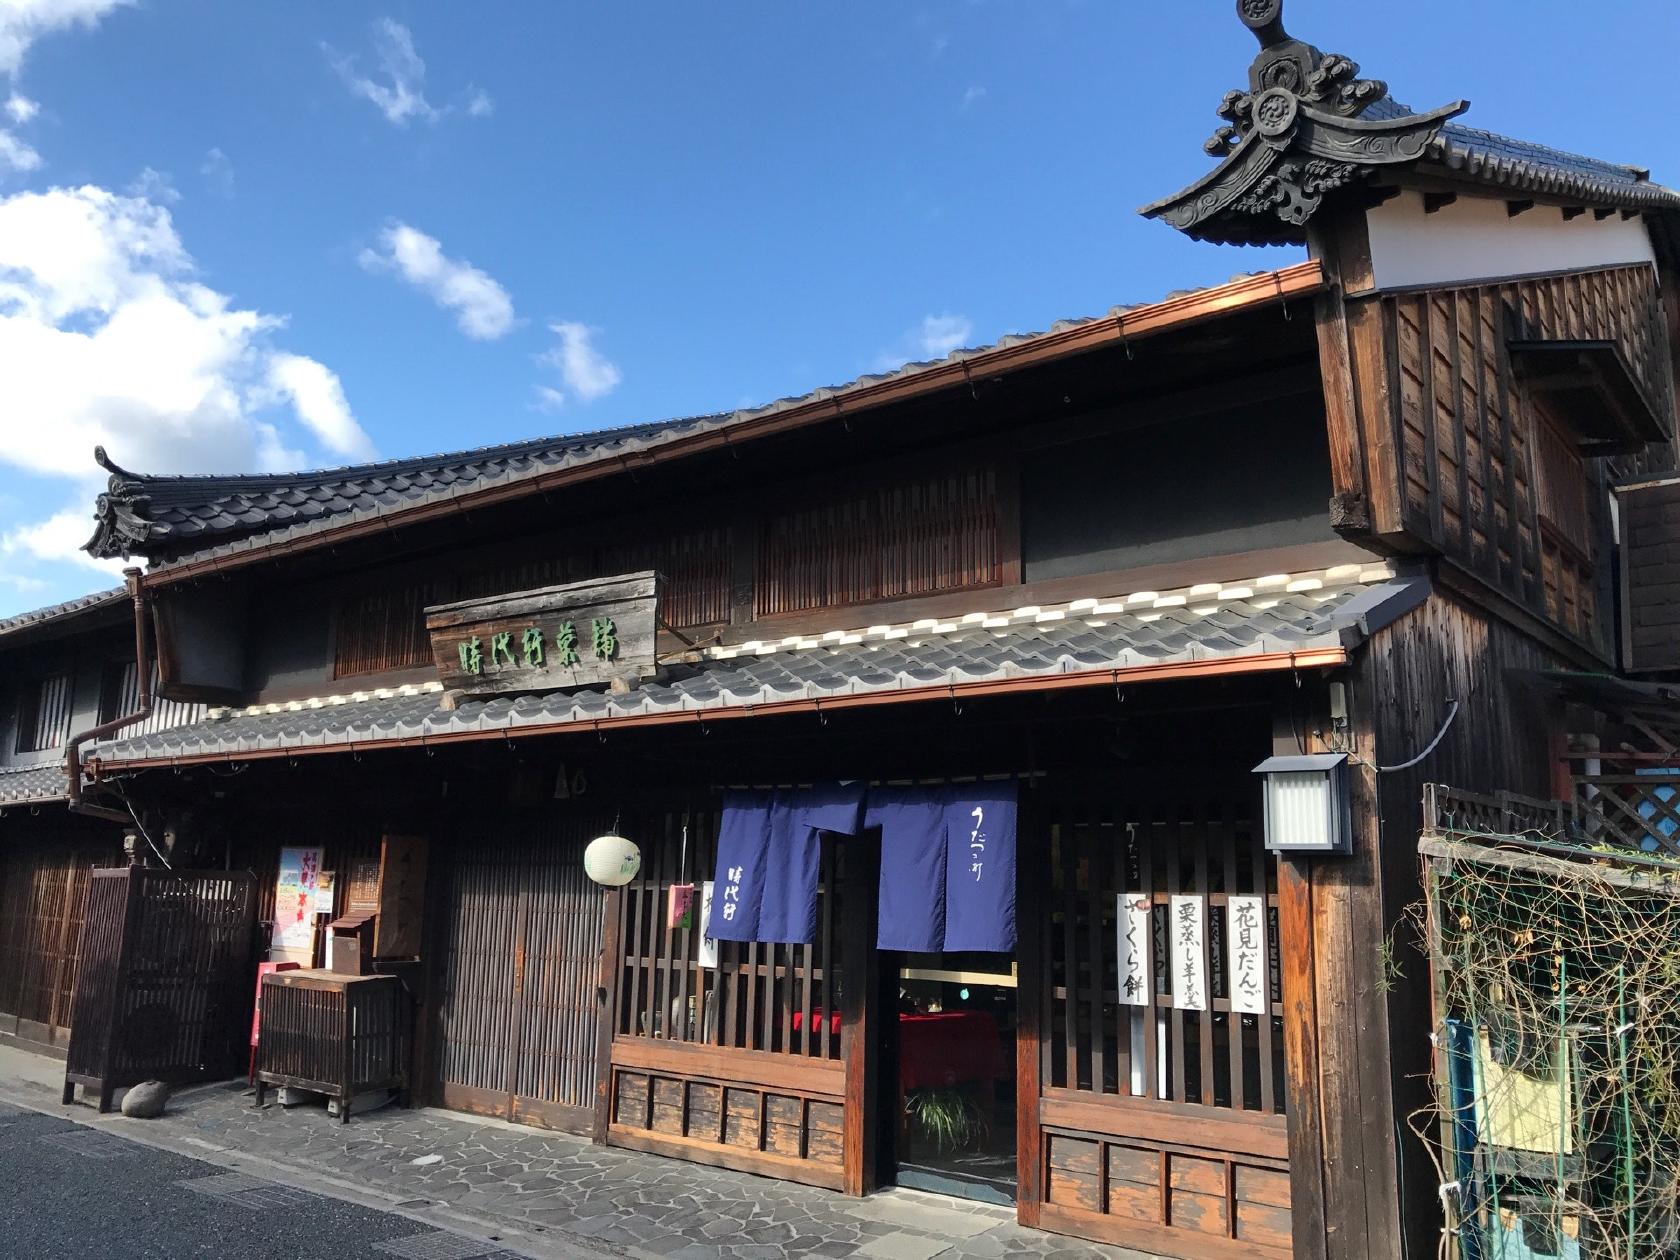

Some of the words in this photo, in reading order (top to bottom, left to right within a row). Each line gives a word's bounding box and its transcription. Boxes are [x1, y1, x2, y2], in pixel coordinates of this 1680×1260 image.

[1122, 898, 1146, 1003] さくら餅
[1178, 902, 1201, 1009] 栗蒸し羊羹
[1234, 901, 1262, 1009] 花見だんご
